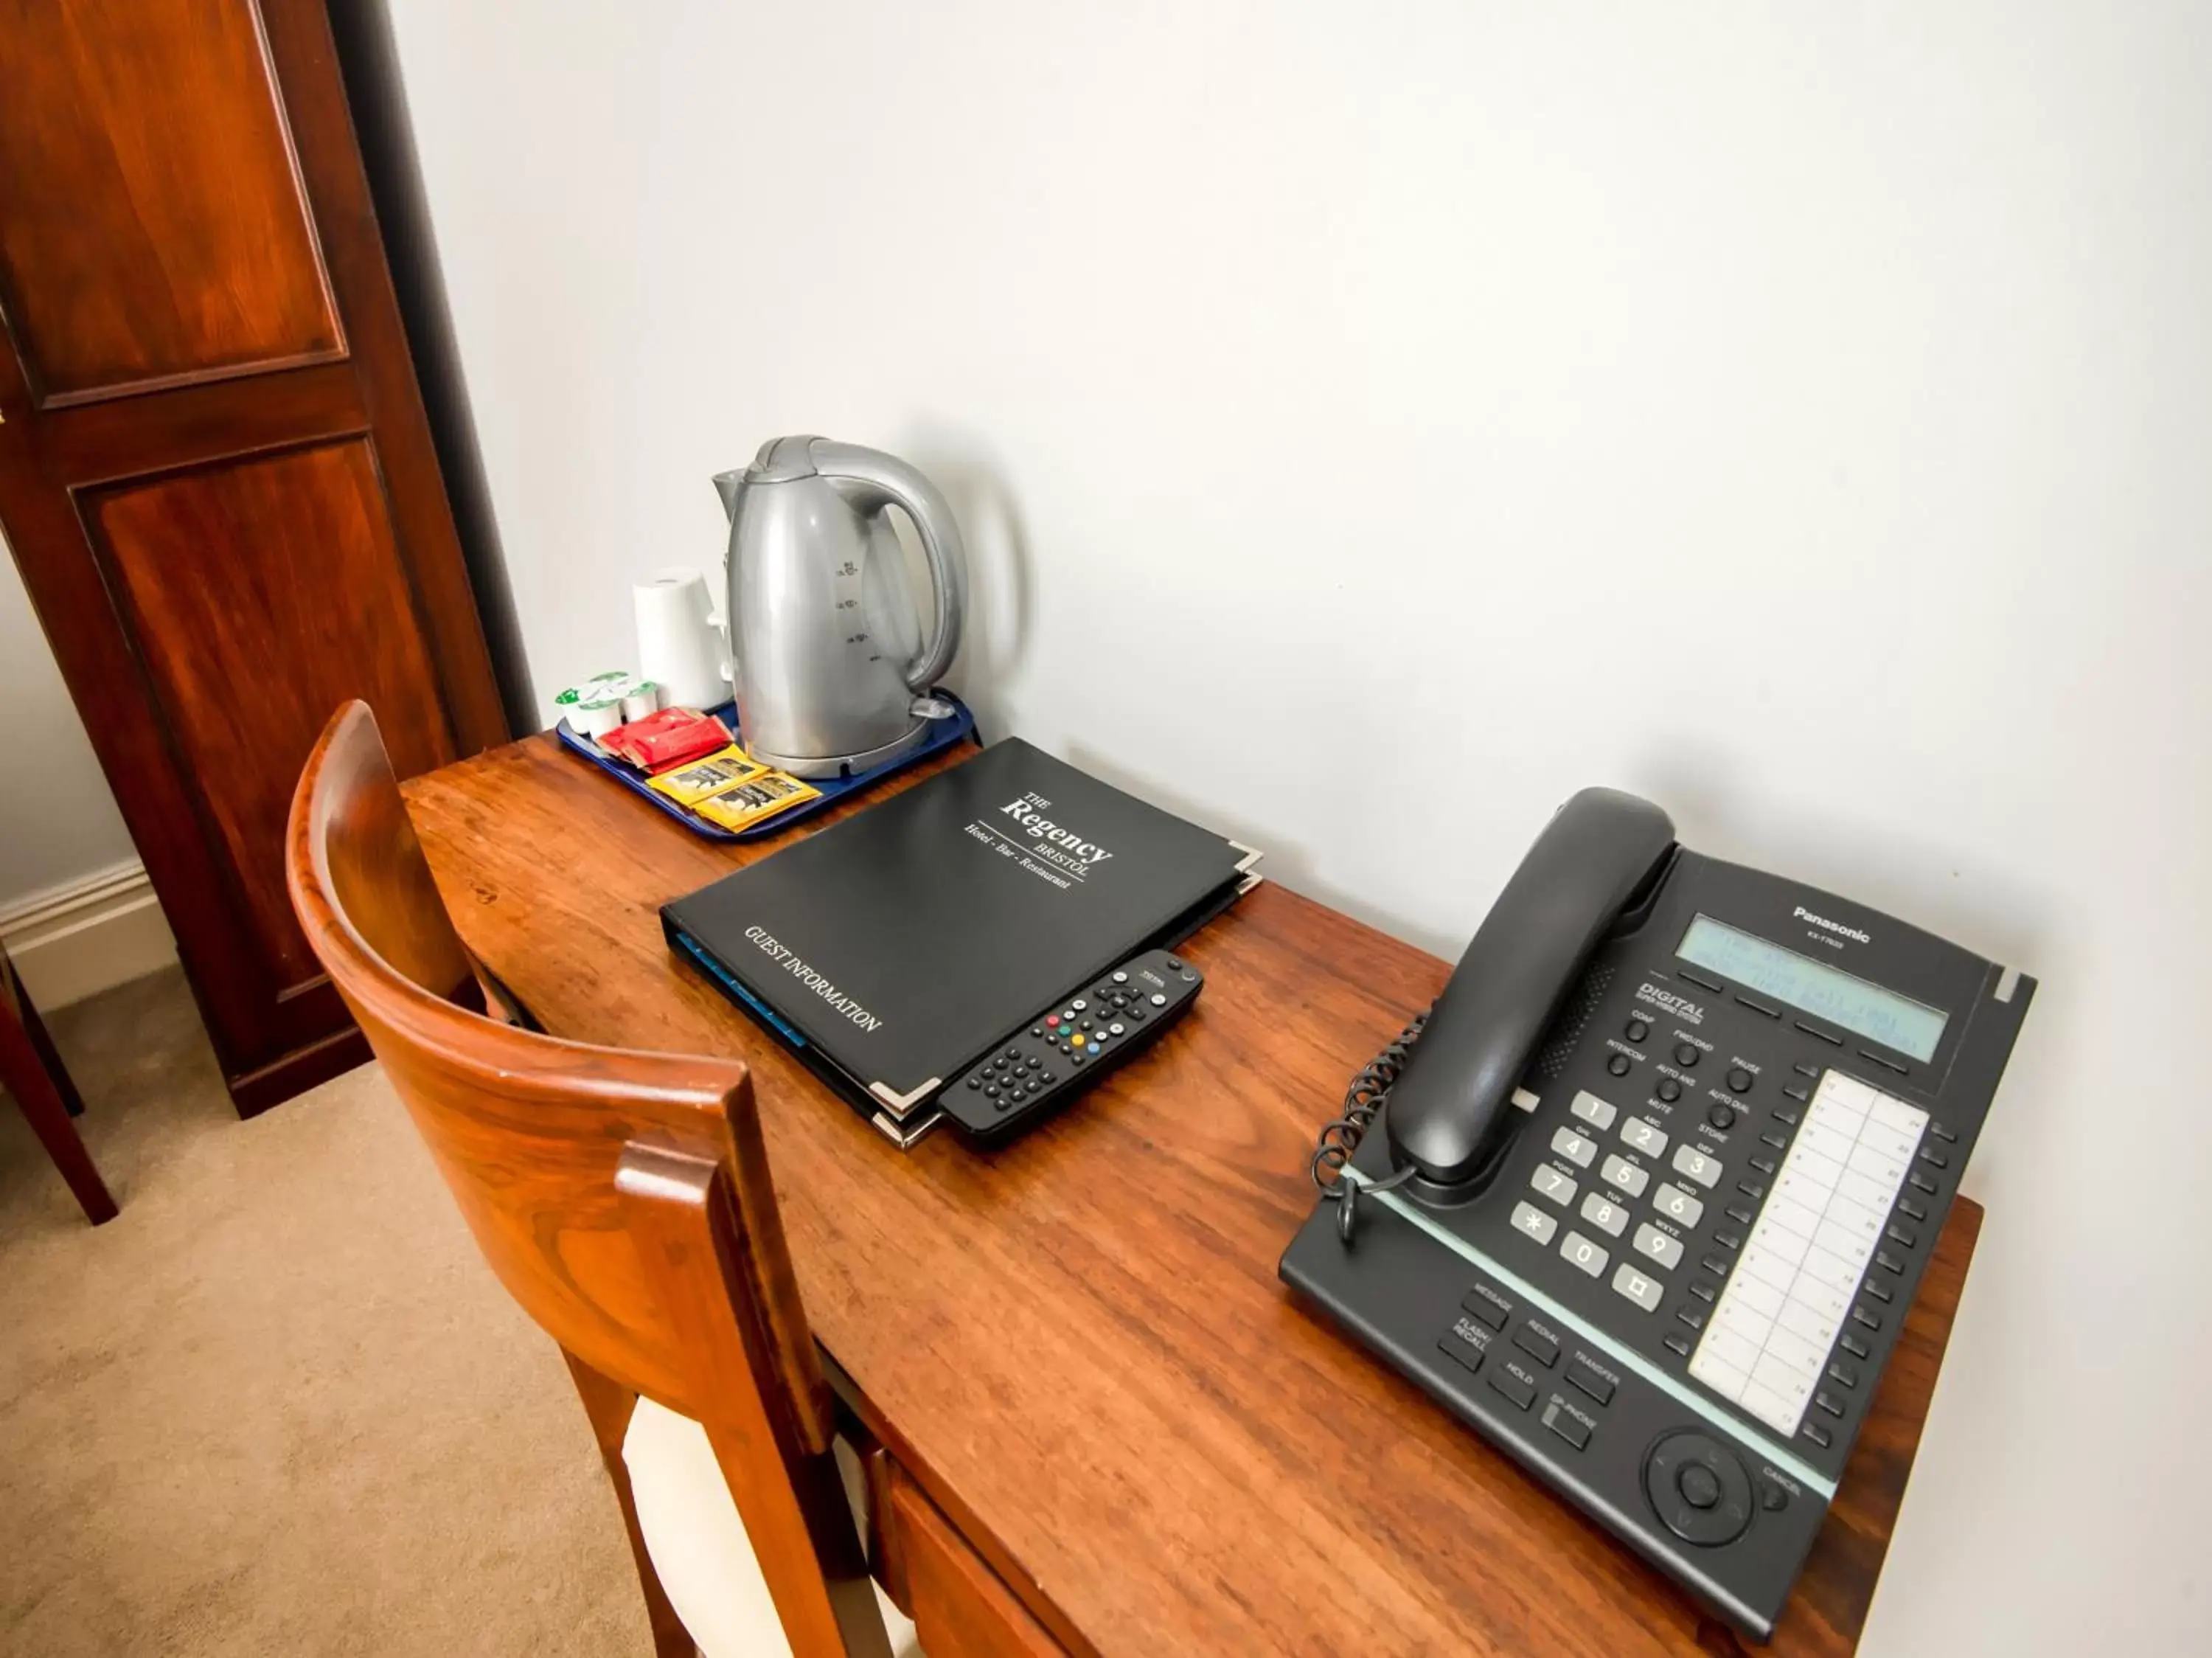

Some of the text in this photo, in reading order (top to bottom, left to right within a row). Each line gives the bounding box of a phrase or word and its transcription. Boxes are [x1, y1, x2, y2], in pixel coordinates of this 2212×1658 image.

[1023, 791, 1053, 810] THE
[998, 798, 1113, 864] Regency
[964, 824, 993, 844] Hotel
[995, 843, 1015, 857] Bar
[1018, 857, 1071, 889] Restaurant
[1033, 842, 1090, 876] BRISTOL
[1793, 906, 1871, 944] Panasonic
[745, 925, 883, 1033] GUEST INFORMATION
[1639, 982, 1704, 1019] DIGITAL
[1607, 1038, 1646, 1061] INTERCOM
[1656, 1063, 1679, 1078] AUTO
[1731, 1055, 1762, 1074] PAUSE
[1588, 1102, 1600, 1117] 1
[1646, 1097, 1673, 1114] MUTE
[1708, 1088, 1750, 1114] AUTO DIAL
[1636, 1128, 1652, 1147] 2
[1698, 1123, 1730, 1143] STORE
[1566, 1139, 1581, 1155] 4
[1616, 1165, 1632, 1183] 5
[1689, 1156, 1705, 1174] 3
[1547, 1175, 1562, 1191] 7
[1597, 1204, 1613, 1223] 8
[1670, 1197, 1685, 1214] 6
[1576, 1244, 1592, 1263] 0
[1652, 1236, 1666, 1253] 9
[1453, 1324, 1486, 1352] RECALL
[1527, 1319, 1561, 1345] REDIAL
[1506, 1362, 1534, 1385] HOLD
[1575, 1350, 1621, 1385] TRANSFER
